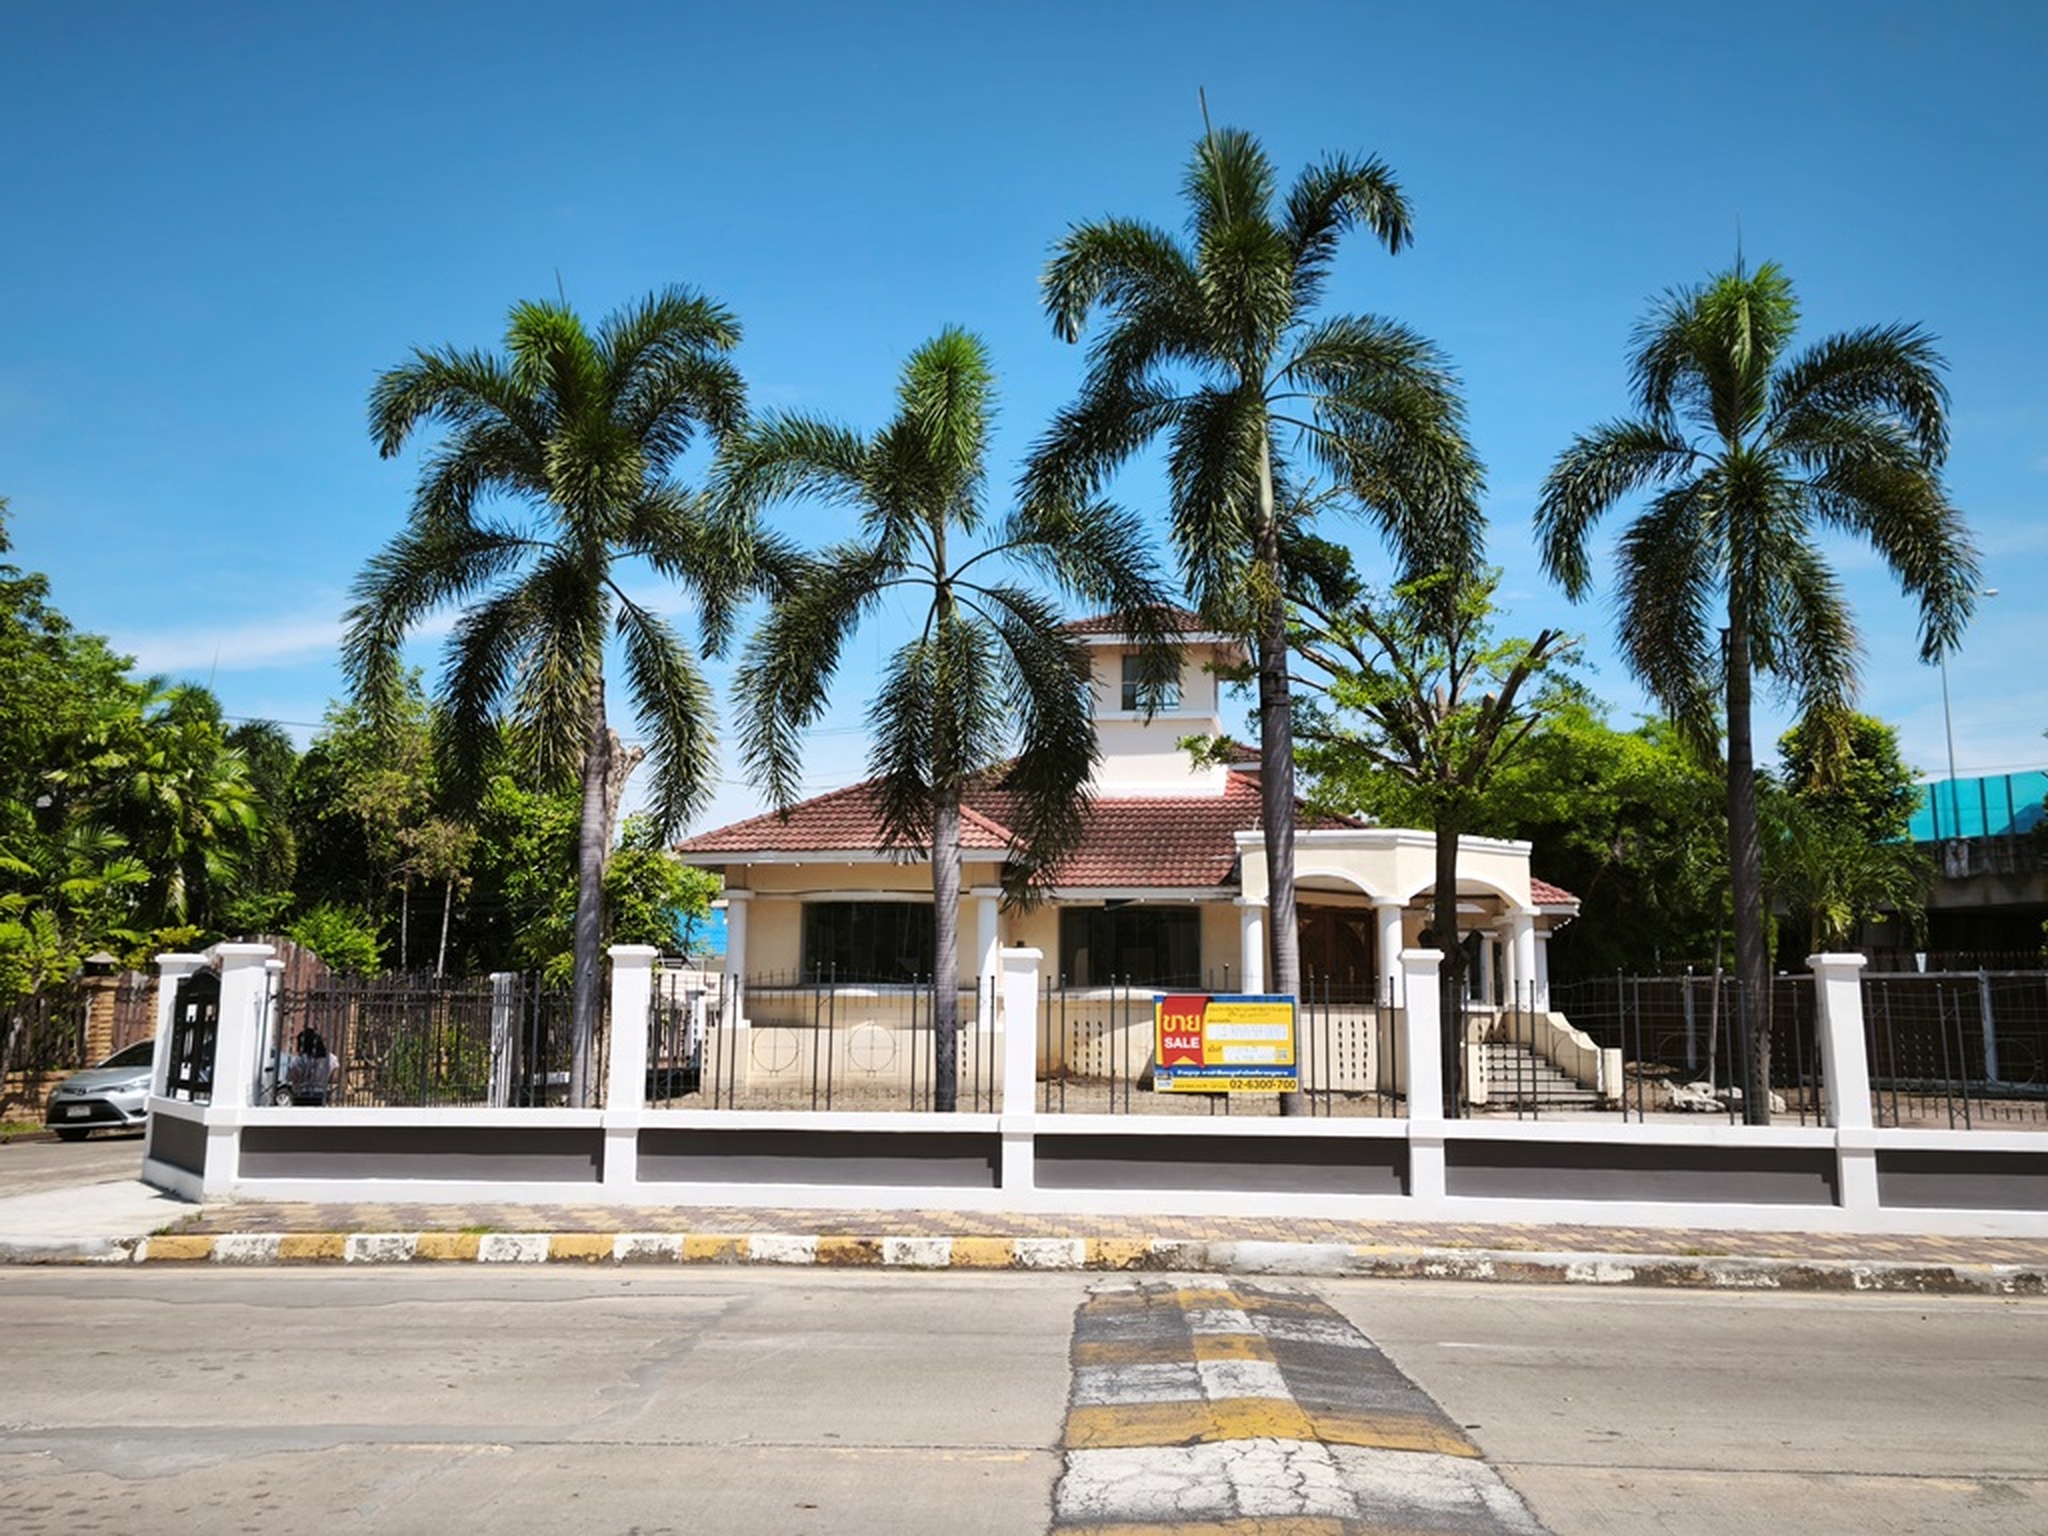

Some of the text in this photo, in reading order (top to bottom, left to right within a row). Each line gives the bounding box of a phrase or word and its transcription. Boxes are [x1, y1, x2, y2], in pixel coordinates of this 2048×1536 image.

[1163, 1014, 1201, 1033] ขาย
[1164, 1037, 1200, 1049] SALE
[1229, 1079, 1297, 1090] 02-6300-700
